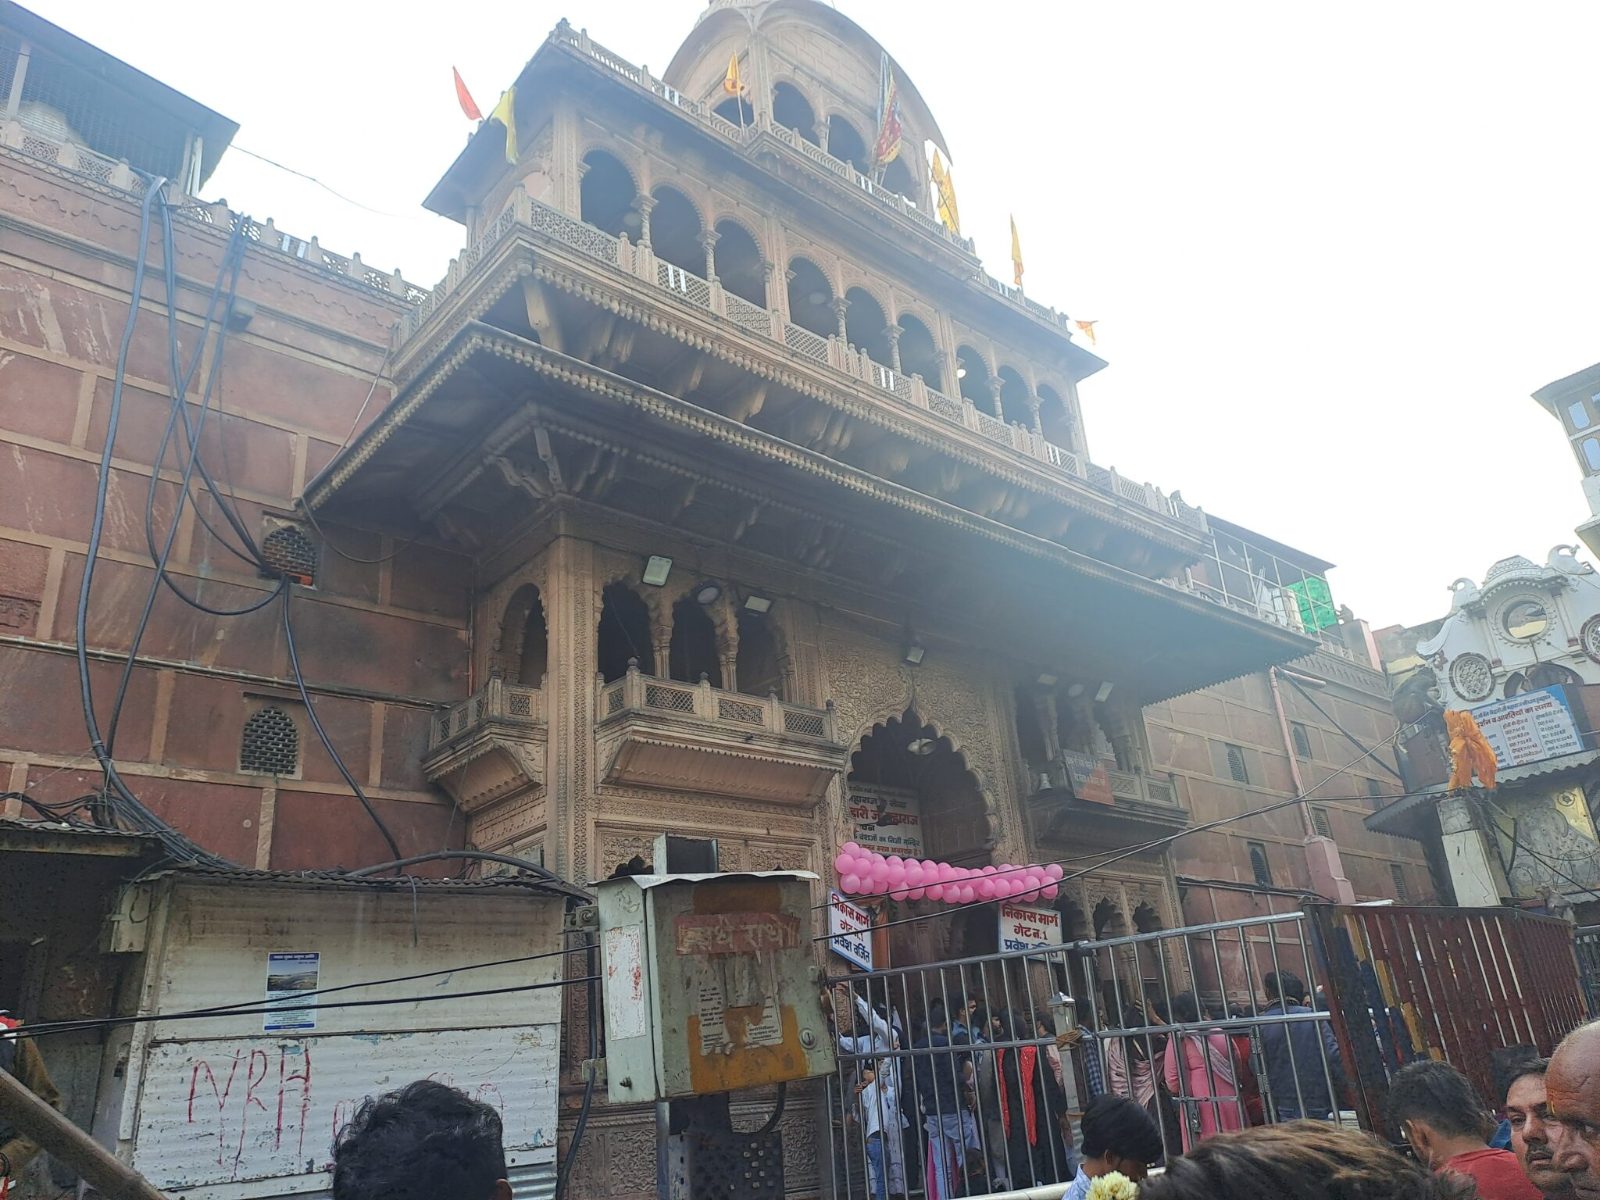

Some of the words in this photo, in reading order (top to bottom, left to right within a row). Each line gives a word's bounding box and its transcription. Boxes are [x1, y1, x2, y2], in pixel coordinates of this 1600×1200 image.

[1525, 706, 1534, 714] का
[1002, 904, 1037, 923] निकास
[1038, 913, 1059, 927] मार्ग
[1003, 938, 1029, 950] प्रवेश
